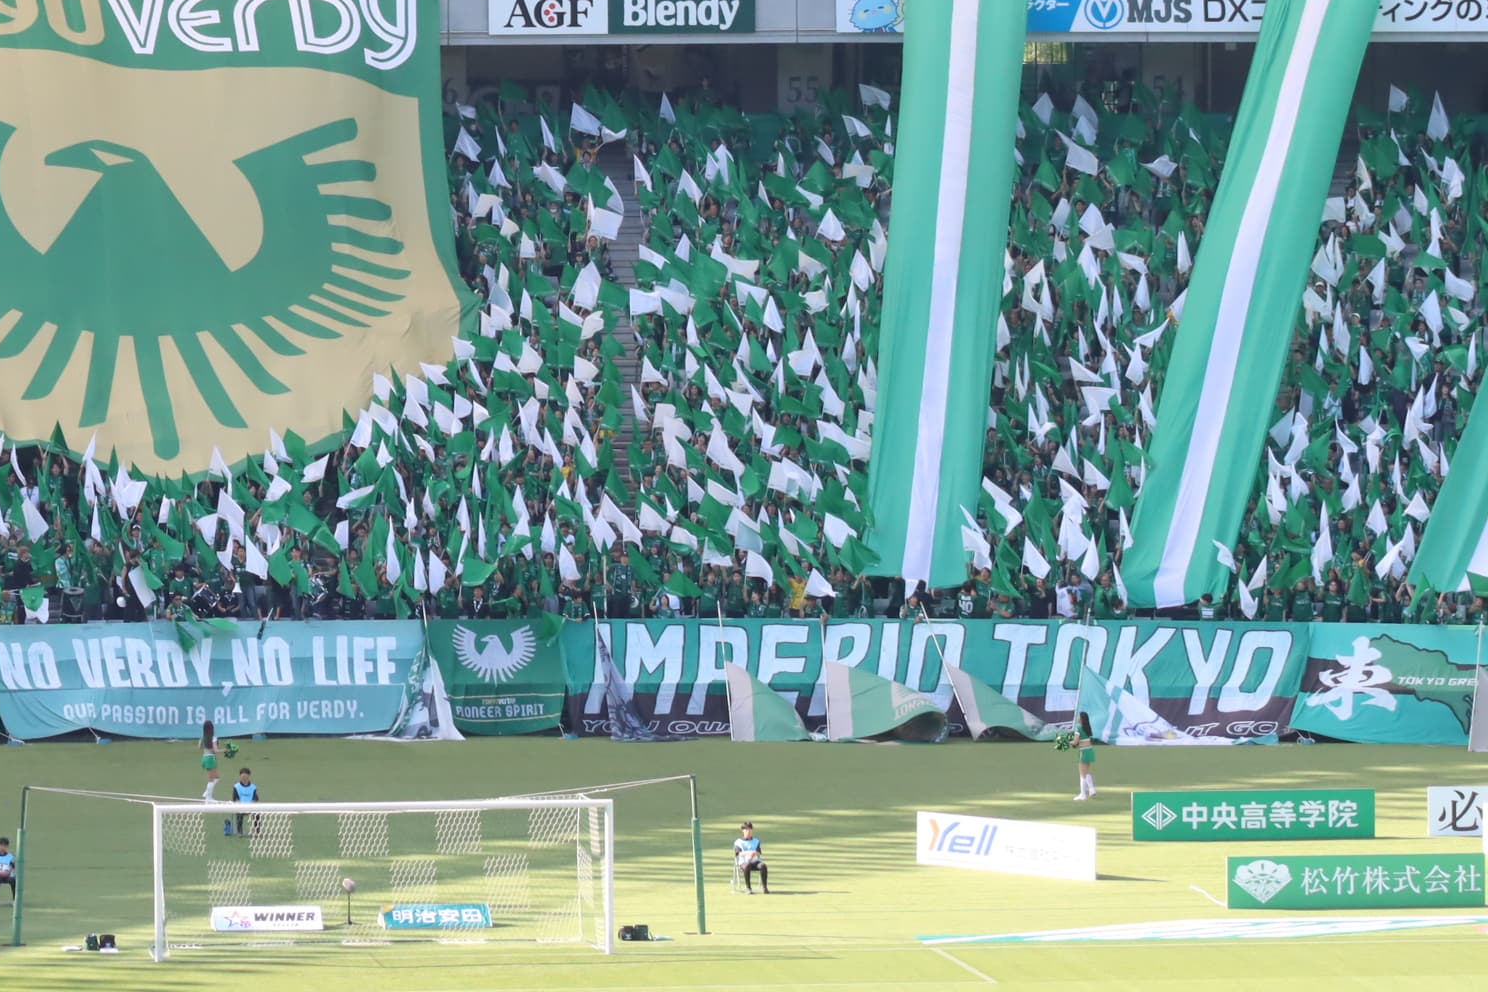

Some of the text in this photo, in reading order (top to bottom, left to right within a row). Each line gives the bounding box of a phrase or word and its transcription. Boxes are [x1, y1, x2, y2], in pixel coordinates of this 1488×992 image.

[1306, 636, 1398, 720] 東
[1397, 676, 1444, 686] TOKYO
[63, 703, 97, 722] OUR
[101, 705, 179, 725] PASSION
[214, 704, 250, 723] ALL
[257, 702, 290, 721] FOR
[297, 700, 365, 720] VERDY.
[505, 704, 544, 717] SPIRIT
[1181, 800, 1359, 830] 中央高等学院
[928, 818, 998, 856] Yell
[1300, 865, 1481, 895] 松竹株式会社
[254, 912, 316, 922] WINNER
[393, 908, 485, 924] 明治安田
